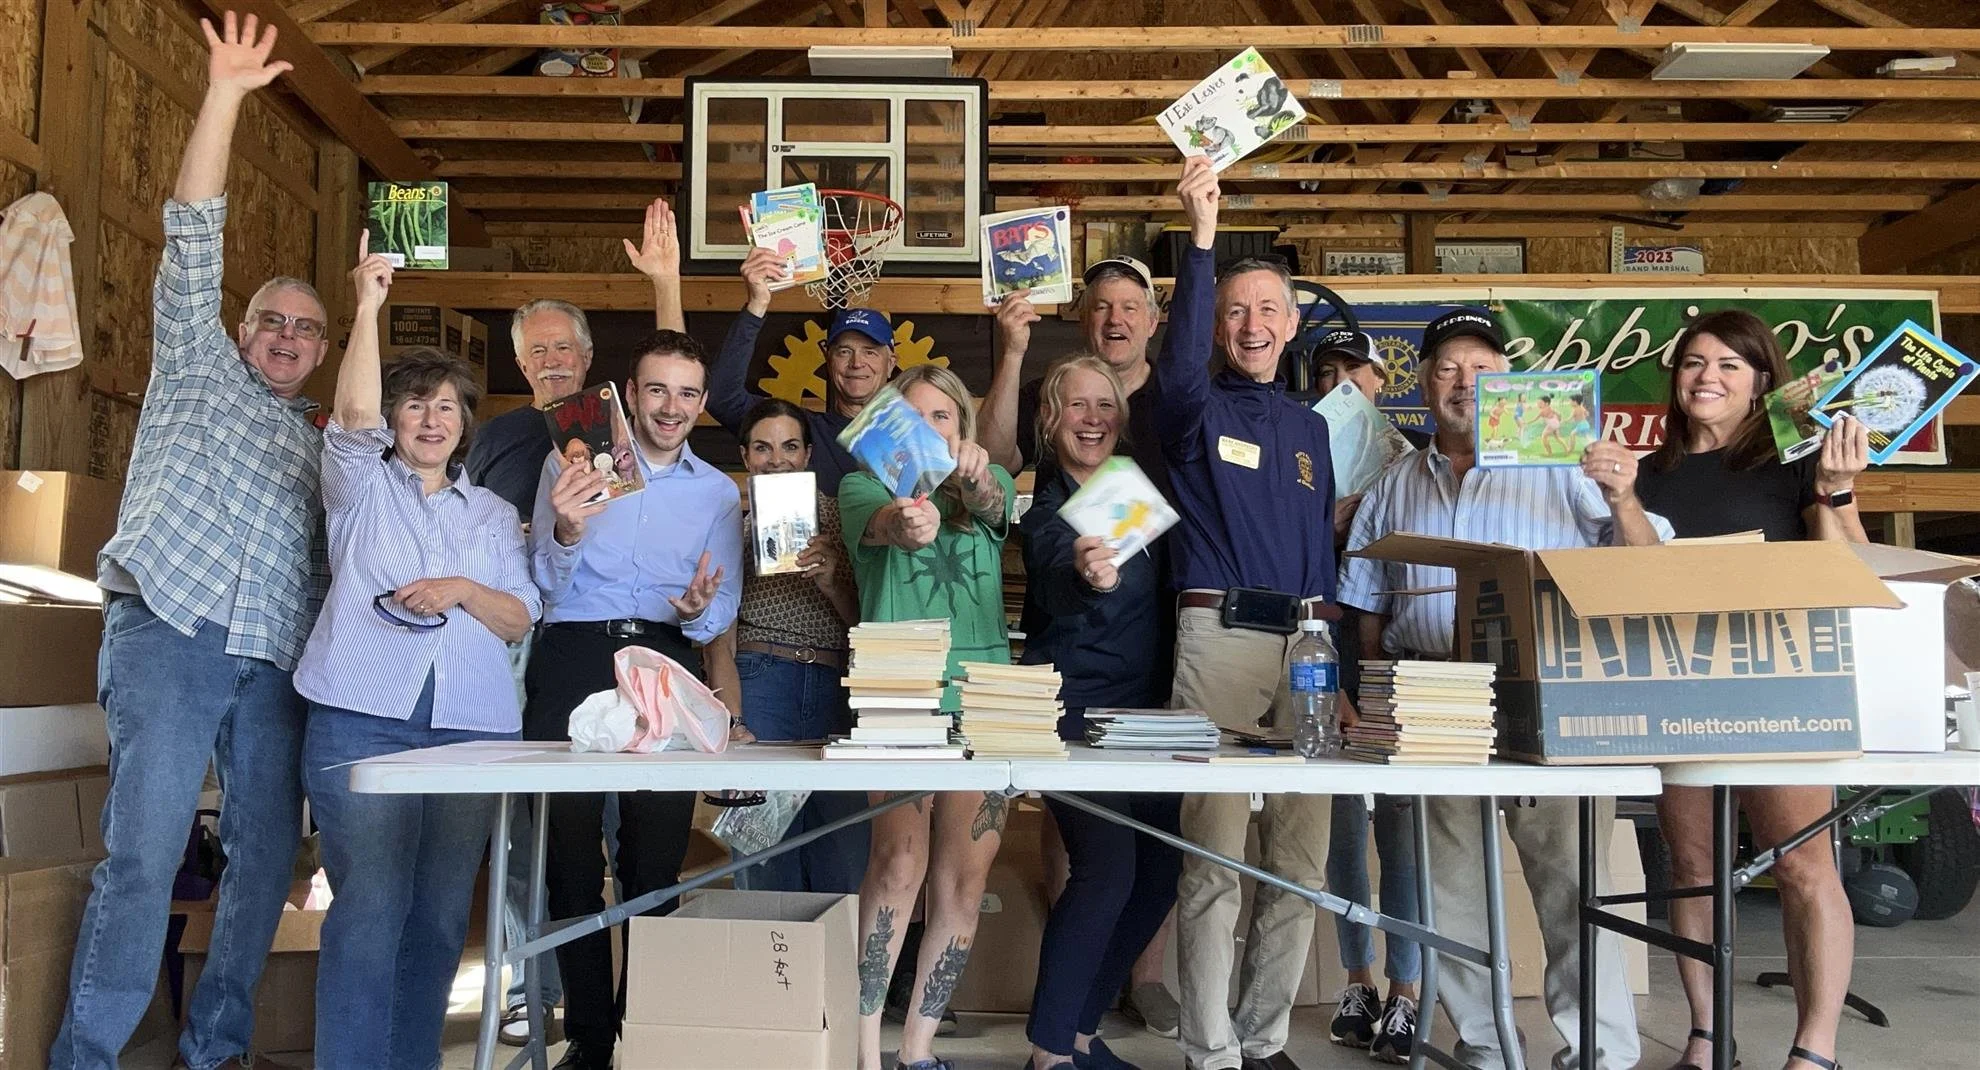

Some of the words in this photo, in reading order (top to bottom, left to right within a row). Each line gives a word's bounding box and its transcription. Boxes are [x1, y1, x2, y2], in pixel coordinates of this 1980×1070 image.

[1172, 100, 1193, 120] Eat
[1192, 77, 1226, 105] Leaves
[388, 184, 426, 200] Beans
[993, 221, 1050, 250] BATS
[1436, 247, 1475, 257] ITALIA
[1636, 251, 1673, 264] 2023
[1652, 264, 1691, 273] MARSHAL
[392, 320, 418, 332] 1000
[1502, 303, 1875, 374] eppio's
[1901, 336, 1916, 353] The
[1915, 347, 1933, 363] Life
[1932, 359, 1956, 379] Cycle
[1902, 354, 1916, 364] of
[1912, 358, 1939, 380] Plants
[1660, 716, 1853, 735] follettcontent.com
[770, 930, 789, 953] 28
